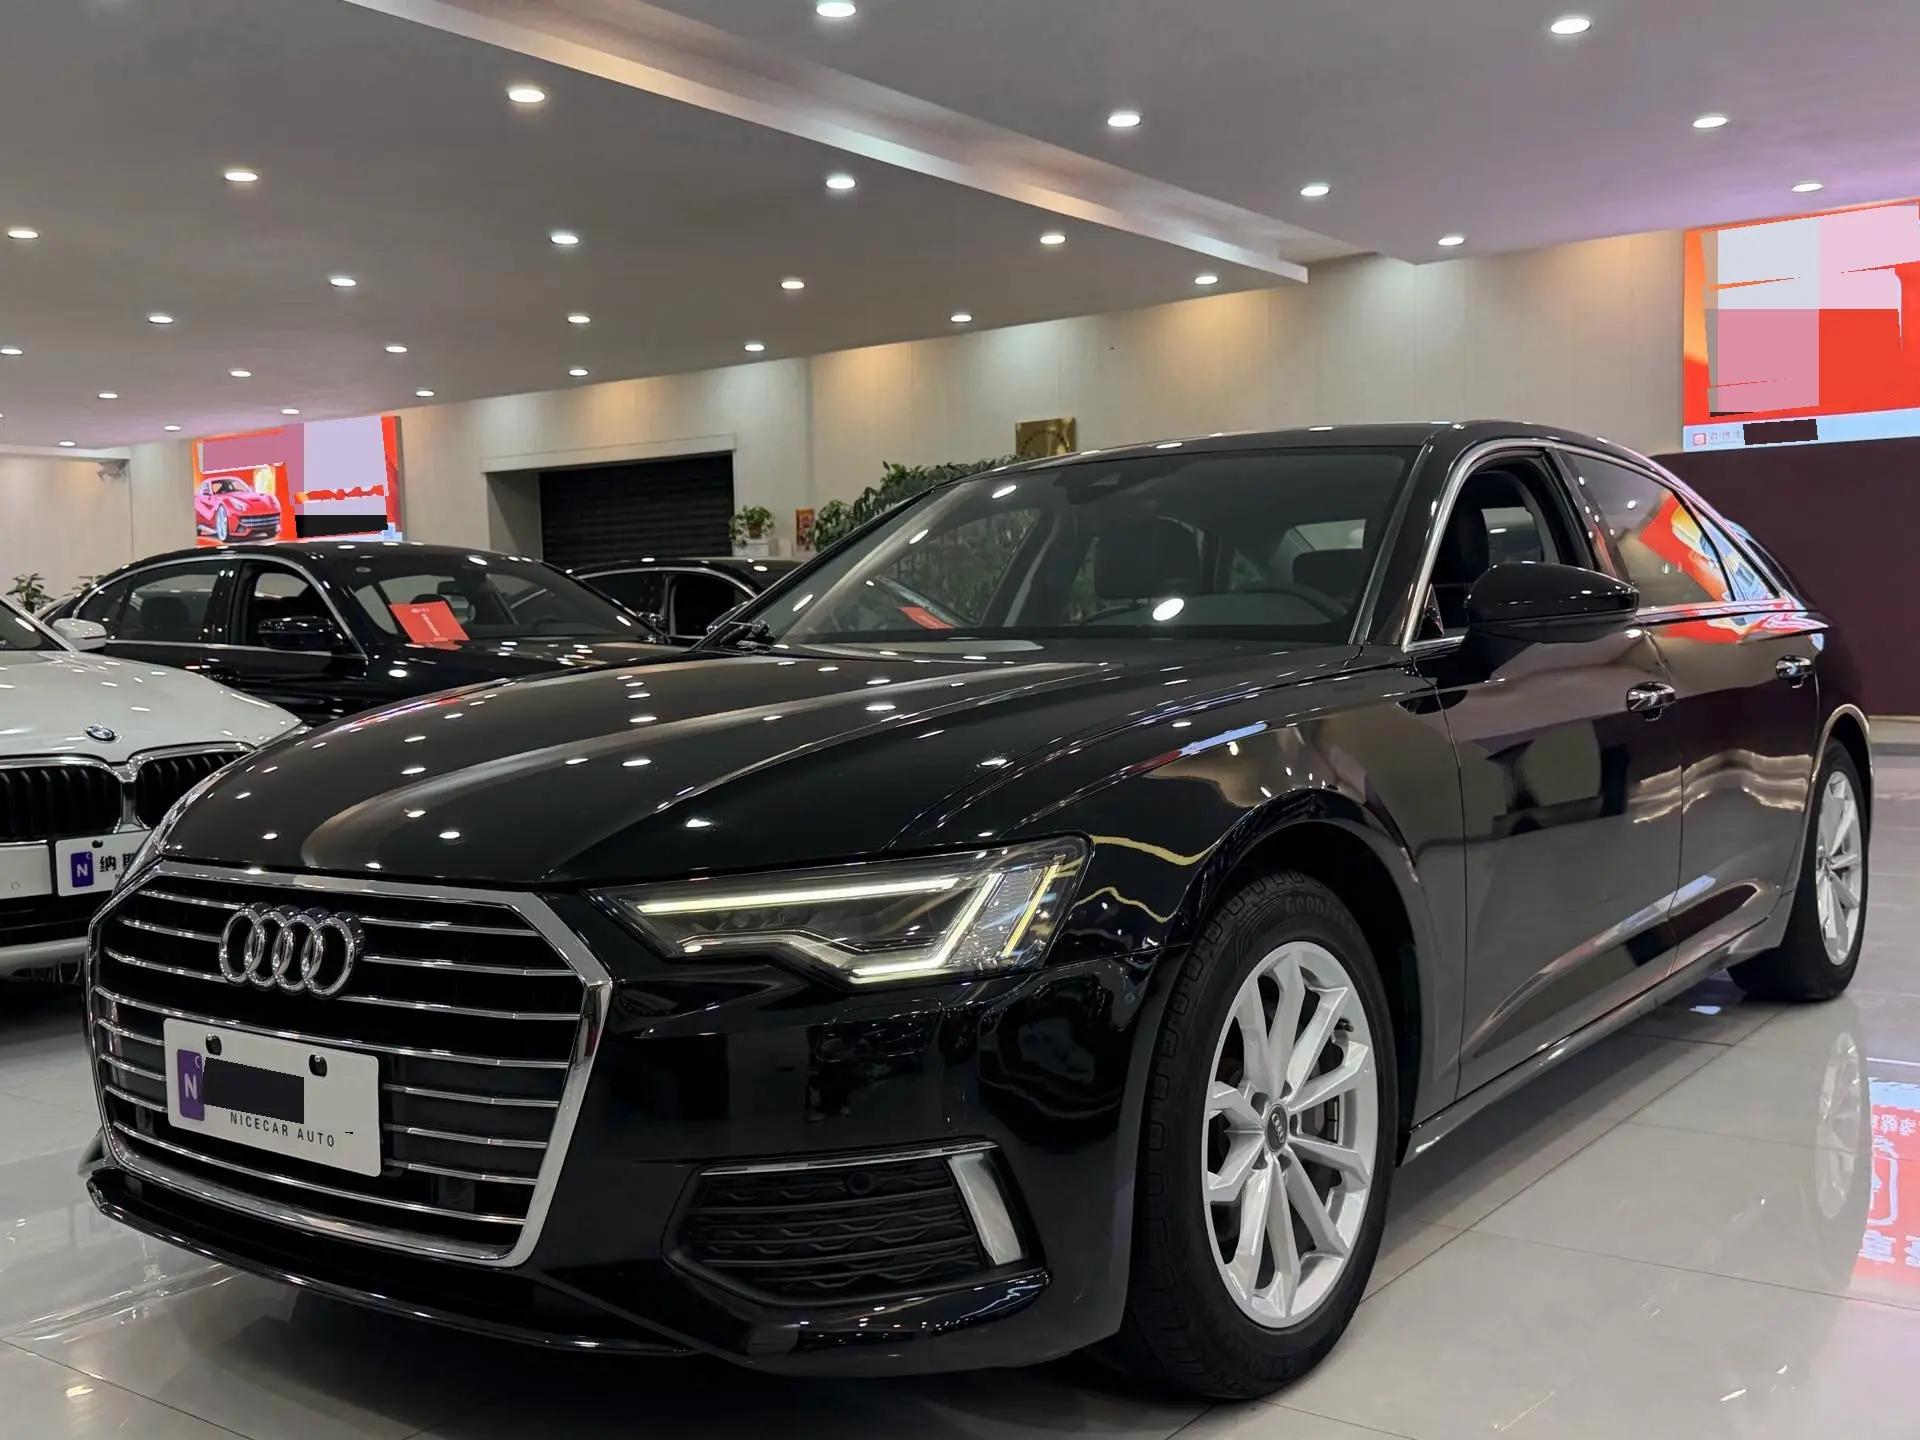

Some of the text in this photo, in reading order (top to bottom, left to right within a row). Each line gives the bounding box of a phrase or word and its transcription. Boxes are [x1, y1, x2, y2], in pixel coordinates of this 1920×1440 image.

[76, 863, 89, 877] N
[184, 1072, 198, 1100] N
[230, 1111, 335, 1147] NICECAR AUTO
